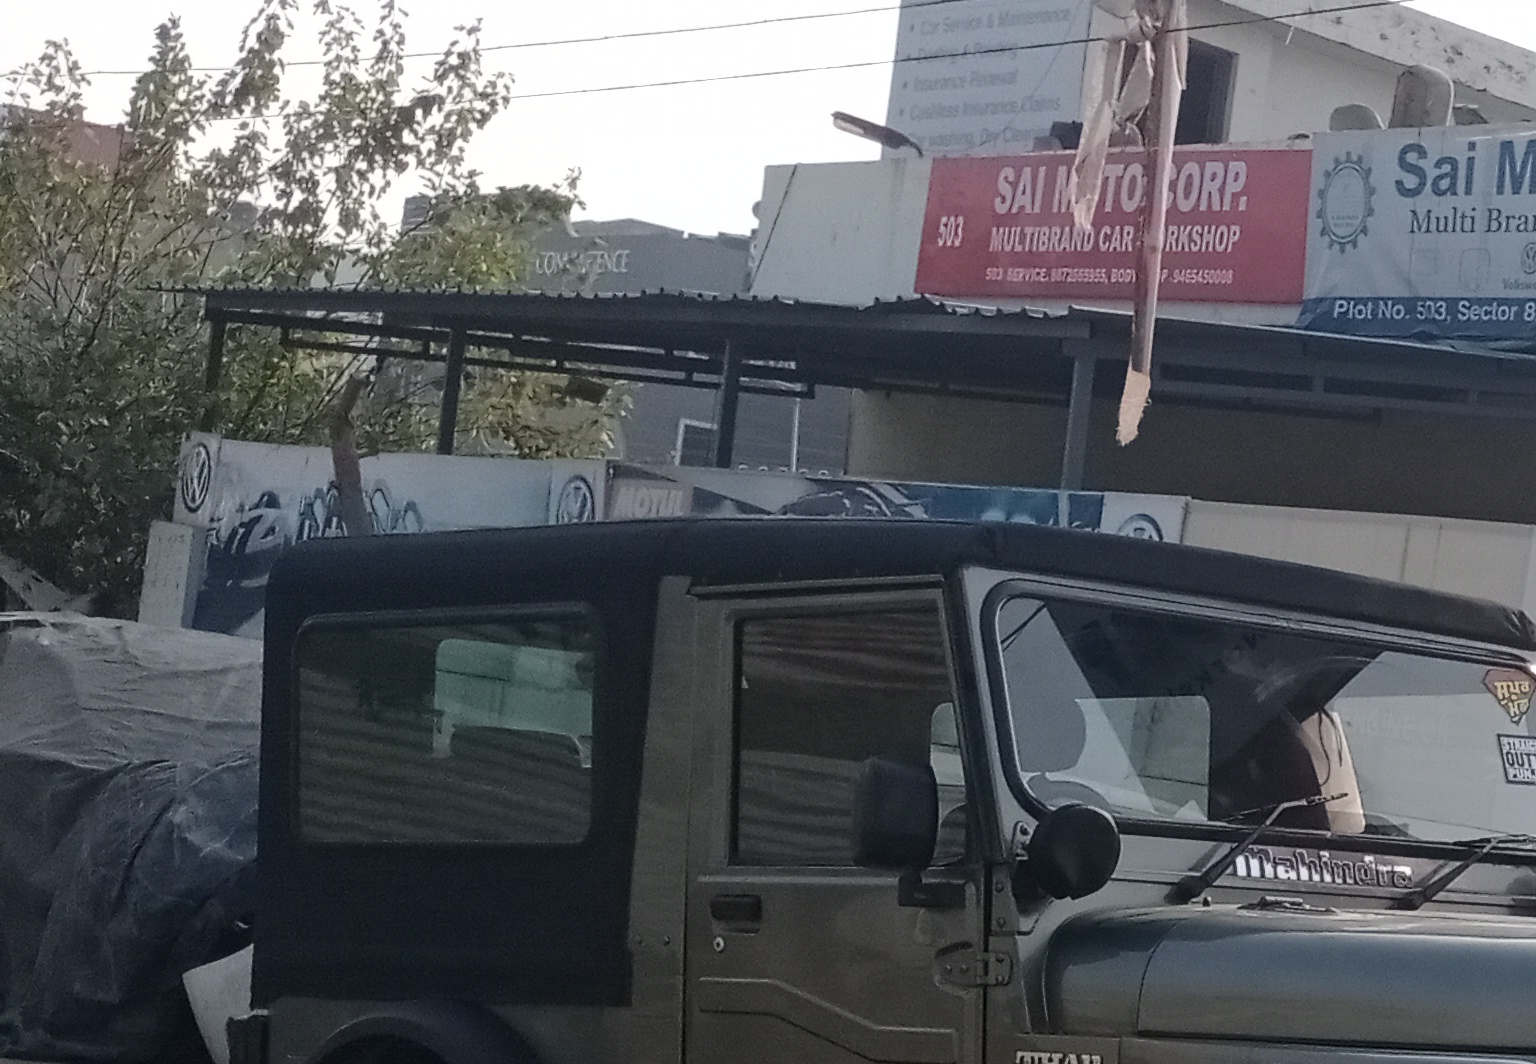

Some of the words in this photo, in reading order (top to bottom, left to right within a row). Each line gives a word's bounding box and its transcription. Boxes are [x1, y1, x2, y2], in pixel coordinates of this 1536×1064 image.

[1394, 141, 1475, 198] Sai
[994, 166, 1047, 214] SAI
[1052, 162, 1143, 213] MTO
[938, 215, 964, 247] 503
[1409, 206, 1476, 235] Multi
[989, 225, 1094, 252] MULTIBRAND
[1099, 226, 1134, 252] CAR
[1162, 226, 1241, 253] RKSHOP
[1333, 300, 1374, 321] Plot
[1378, 301, 1411, 322] No.
[1416, 302, 1453, 323] 503,
[1457, 300, 1519, 323] Sector
[1234, 844, 1413, 889] Mahindra
